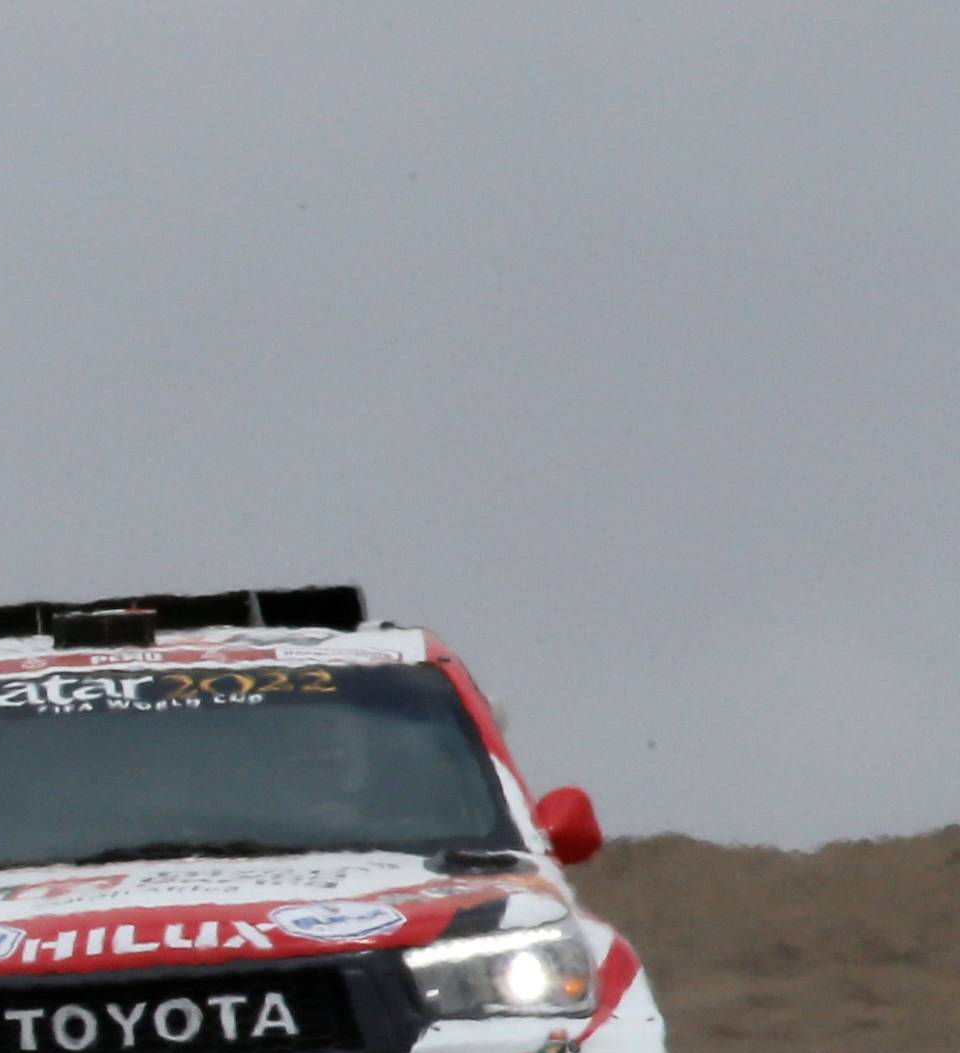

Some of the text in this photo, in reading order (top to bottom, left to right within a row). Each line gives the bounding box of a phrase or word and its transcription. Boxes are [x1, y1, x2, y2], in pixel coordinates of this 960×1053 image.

[106, 697, 202, 711] WORLD
[213, 692, 265, 705] CUP
[160, 669, 337, 700] 2022
[21, 919, 279, 964] HILUX
[4, 991, 301, 1052] TOYOTA
